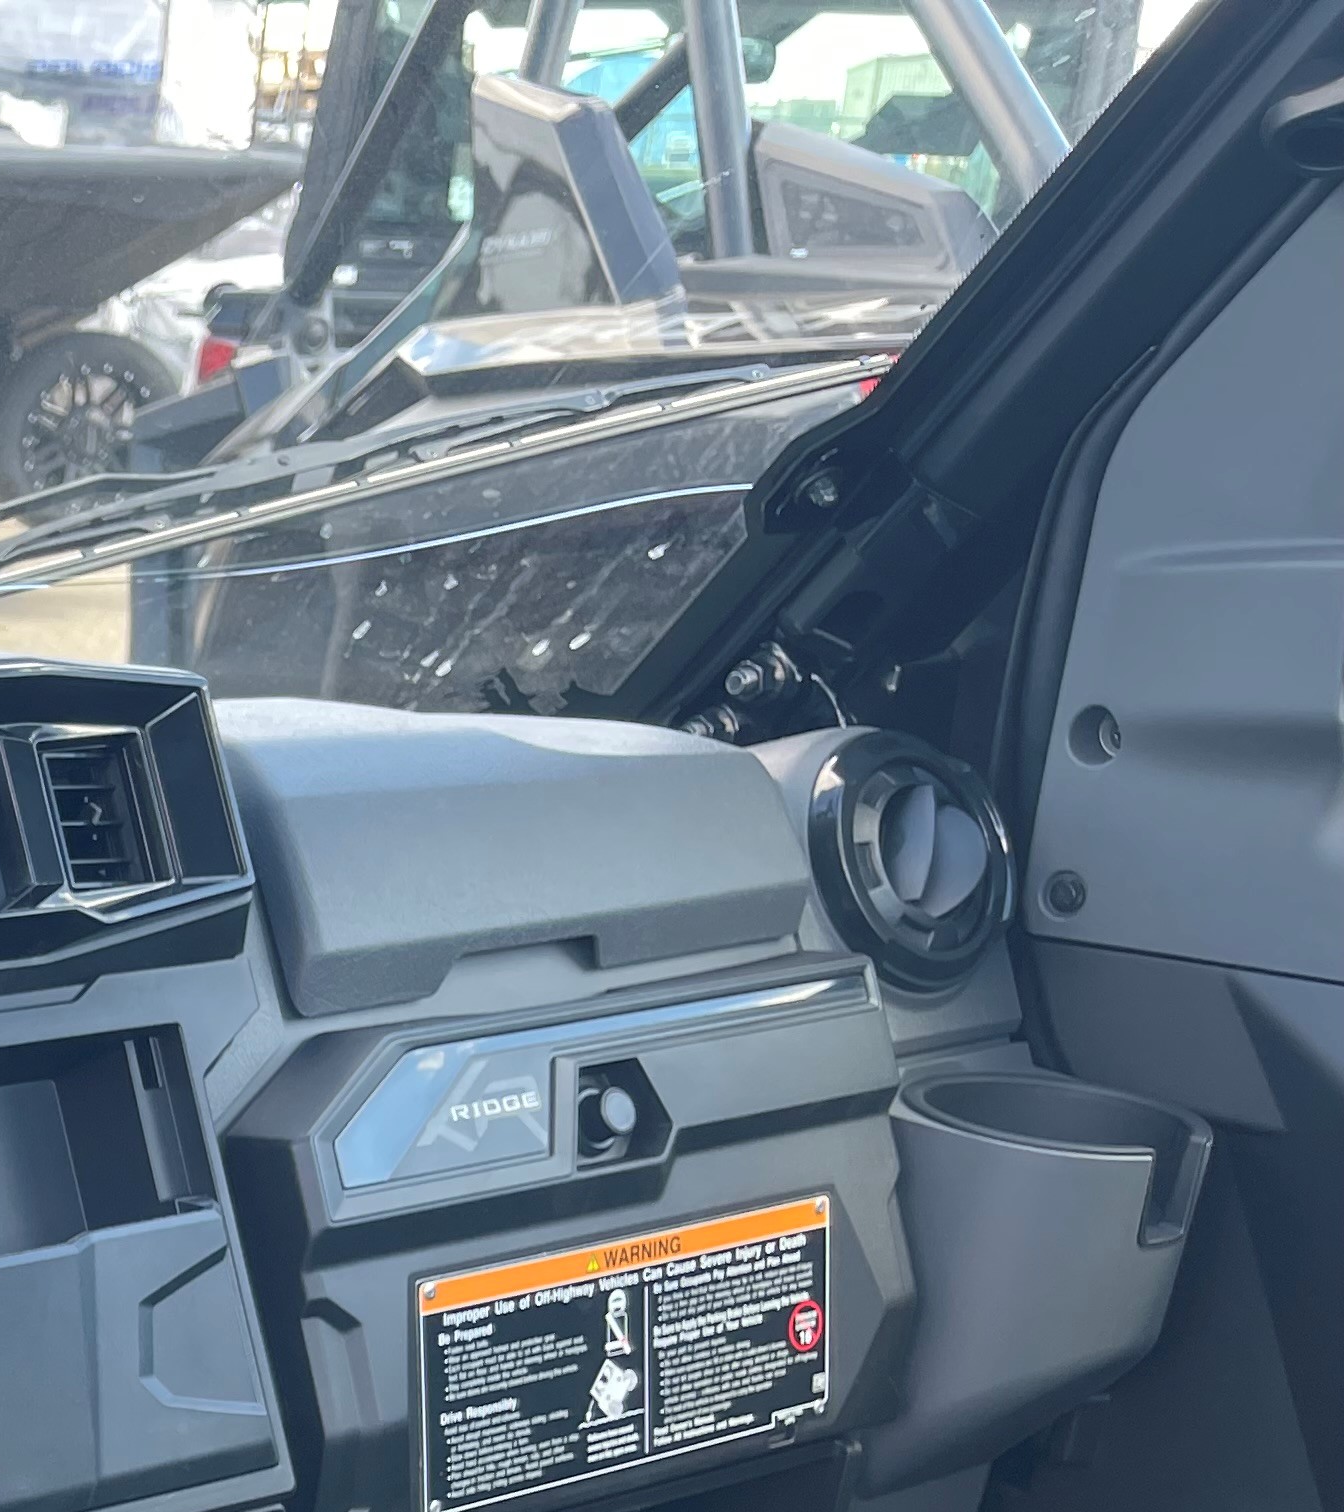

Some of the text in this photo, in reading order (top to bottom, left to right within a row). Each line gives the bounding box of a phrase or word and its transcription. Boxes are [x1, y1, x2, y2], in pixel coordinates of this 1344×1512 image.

[450, 1091, 539, 1121] RIDGE
[603, 1236, 681, 1268] WARNING
[443, 1304, 491, 1327] Improper
[494, 1299, 516, 1317] Use
[519, 1297, 531, 1311] of
[534, 1282, 595, 1307] Off-Highway
[598, 1272, 639, 1292] Vehicles
[642, 1266, 663, 1282] Can
[440, 1411, 463, 1427] Drive
